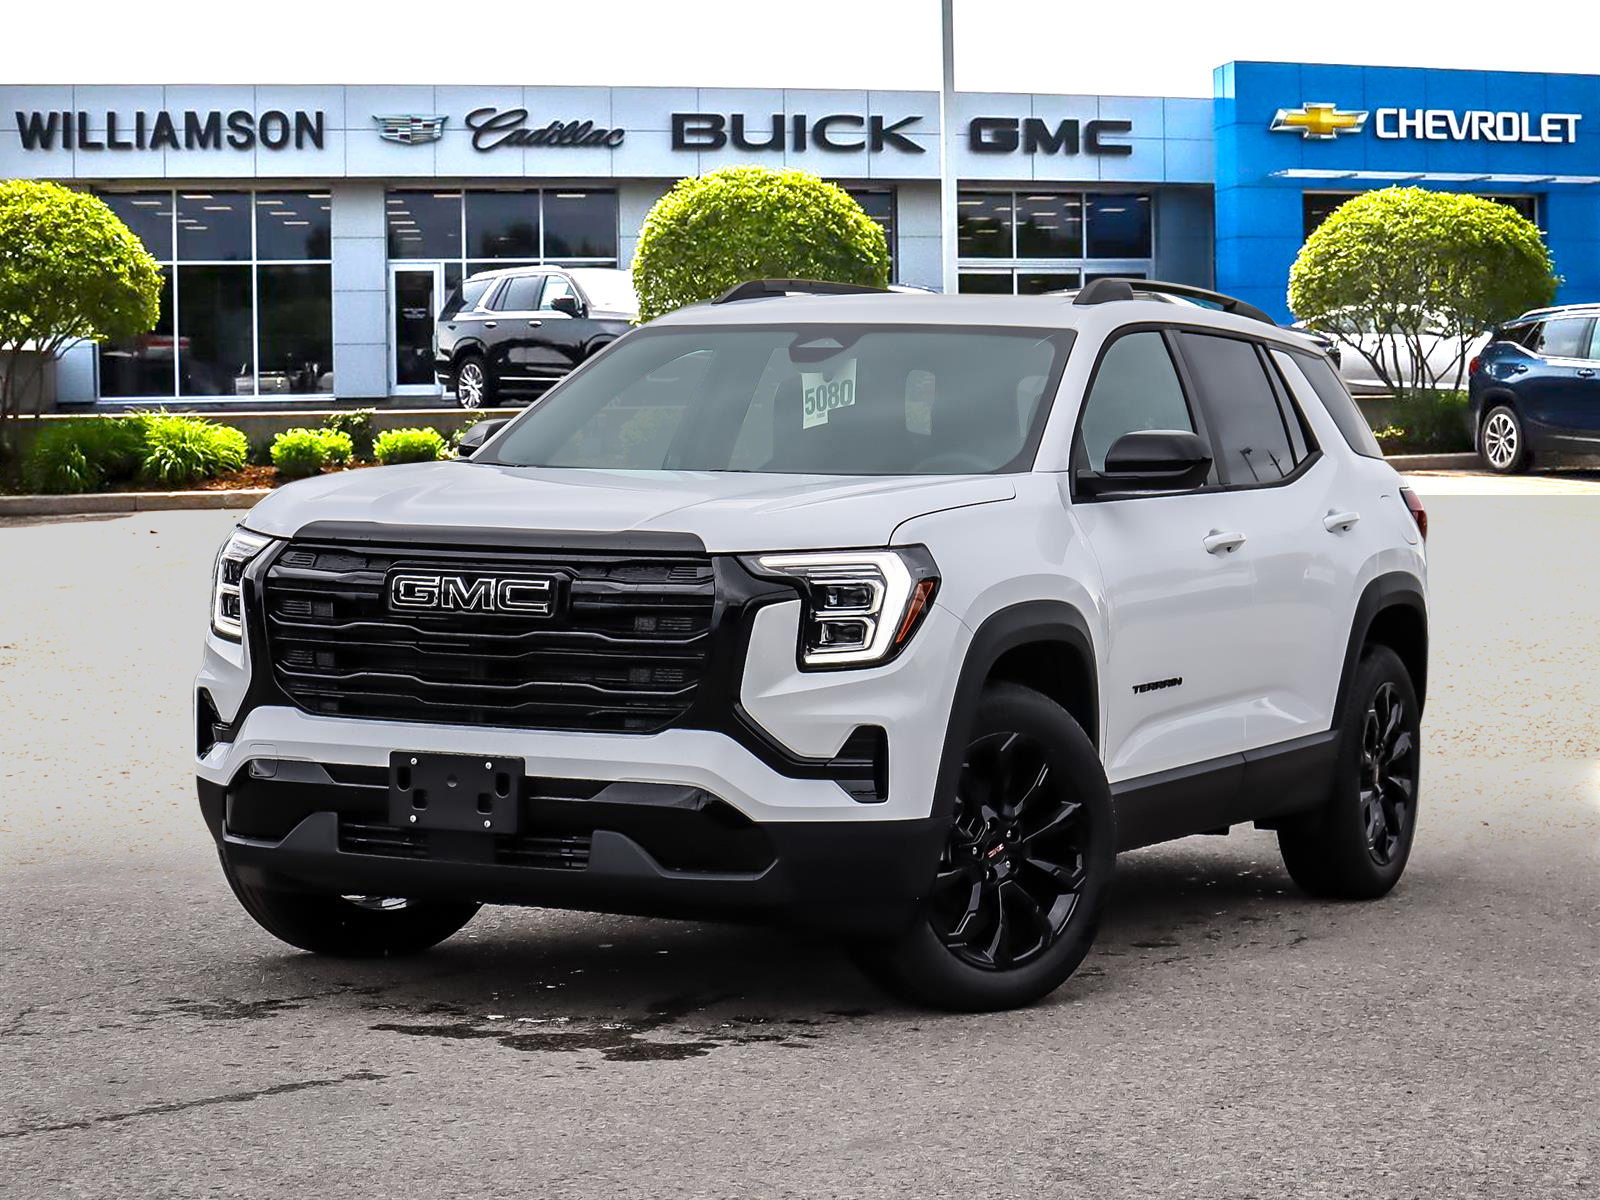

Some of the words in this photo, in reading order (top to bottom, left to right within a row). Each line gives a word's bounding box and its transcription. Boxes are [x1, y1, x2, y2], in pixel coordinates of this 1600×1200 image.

[16, 111, 323, 151] WILLIAMSON
[465, 107, 625, 152] Cadillac
[671, 113, 925, 153] BUICK
[969, 117, 1132, 155] GMC
[1376, 107, 1582, 144] CHEVROLET
[804, 379, 853, 415] 5080
[391, 574, 550, 613] GMC
[1132, 676, 1183, 695] TERRAIN
